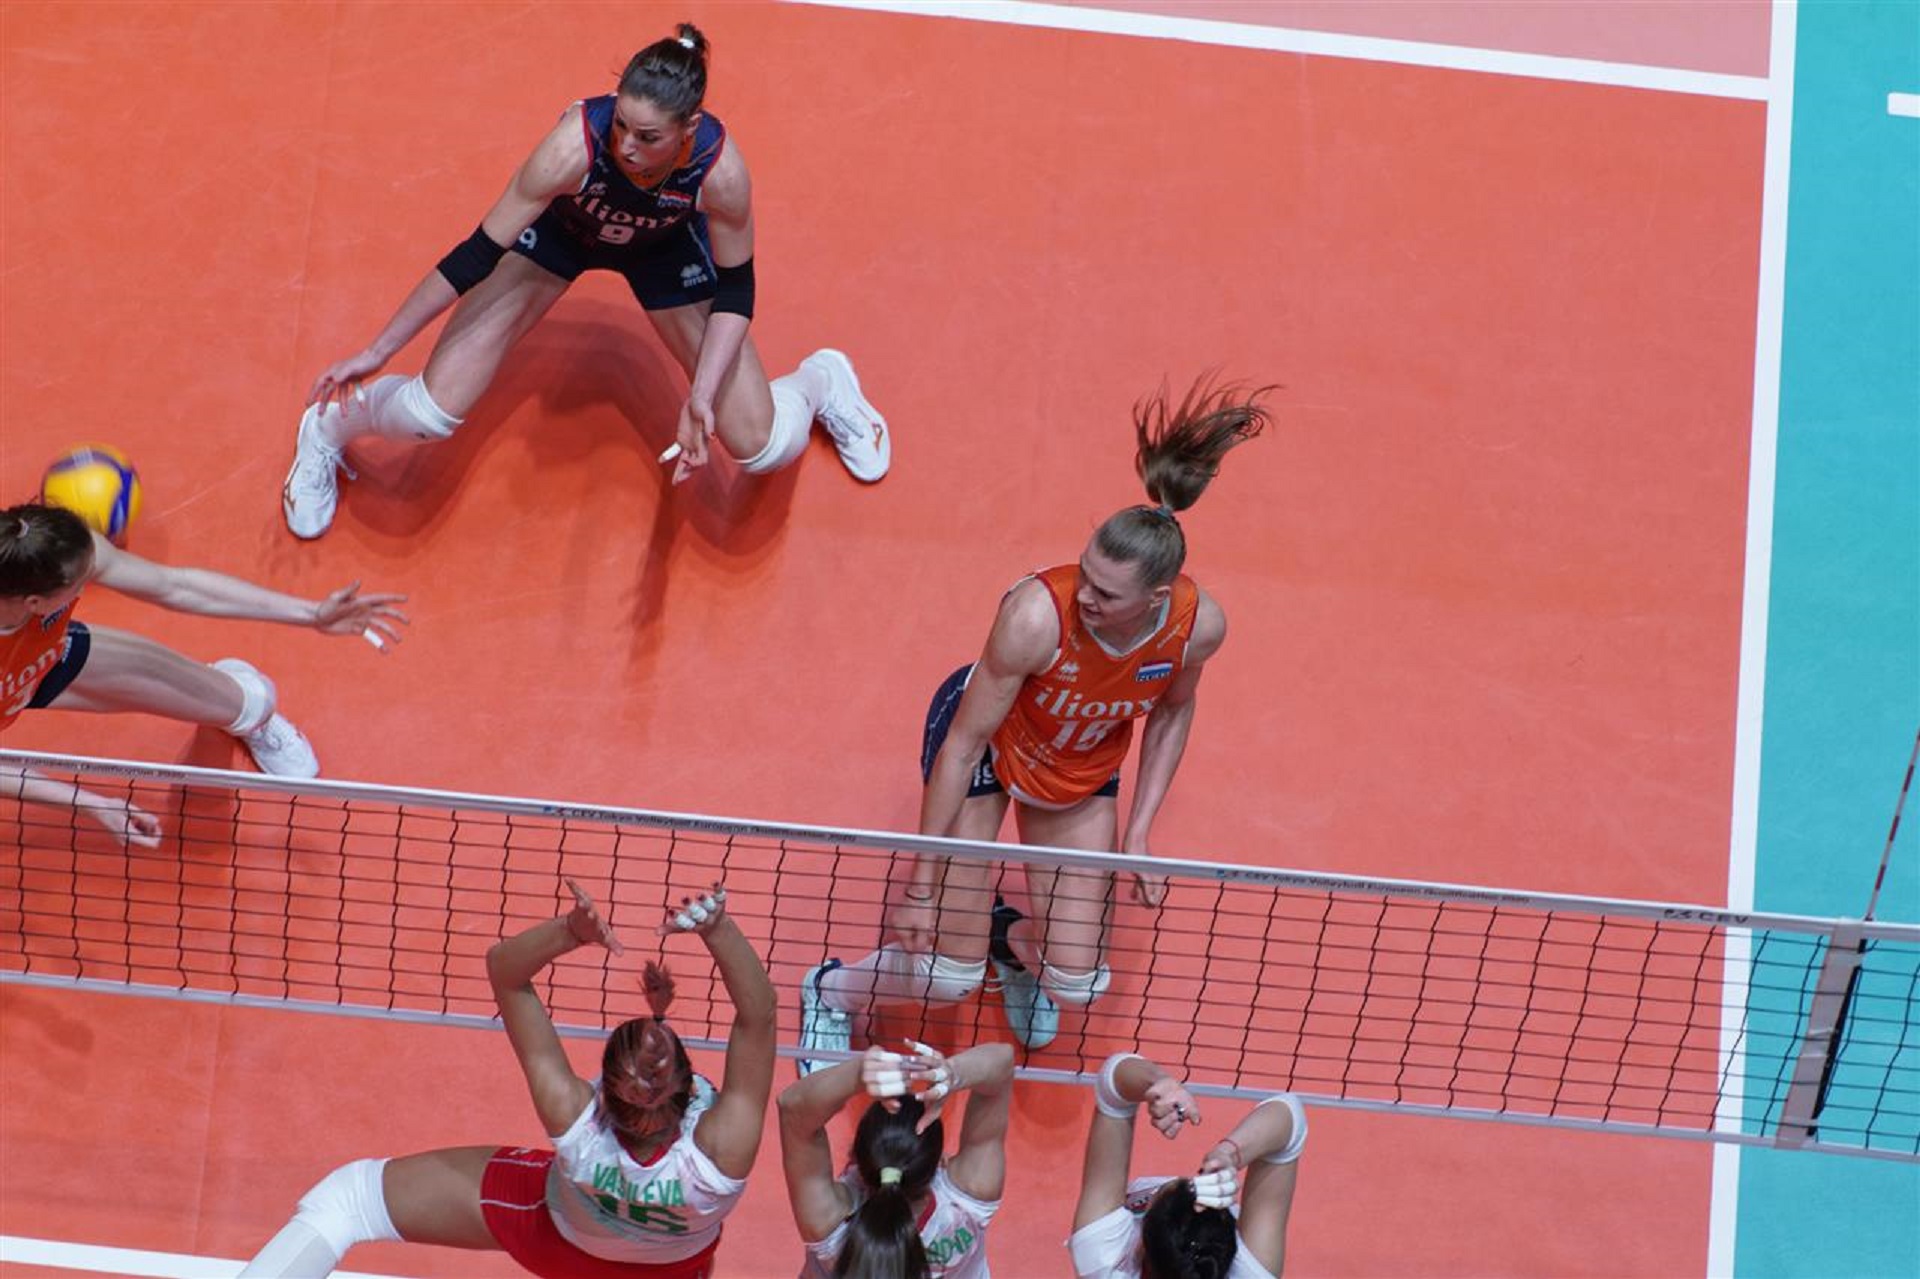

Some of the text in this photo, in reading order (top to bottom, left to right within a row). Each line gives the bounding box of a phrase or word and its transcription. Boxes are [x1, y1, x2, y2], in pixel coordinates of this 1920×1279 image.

[518, 227, 537, 249] 9
[598, 223, 635, 245] 9
[1034, 687, 1155, 718] ilionx
[1699, 912, 1749, 924] CEV
